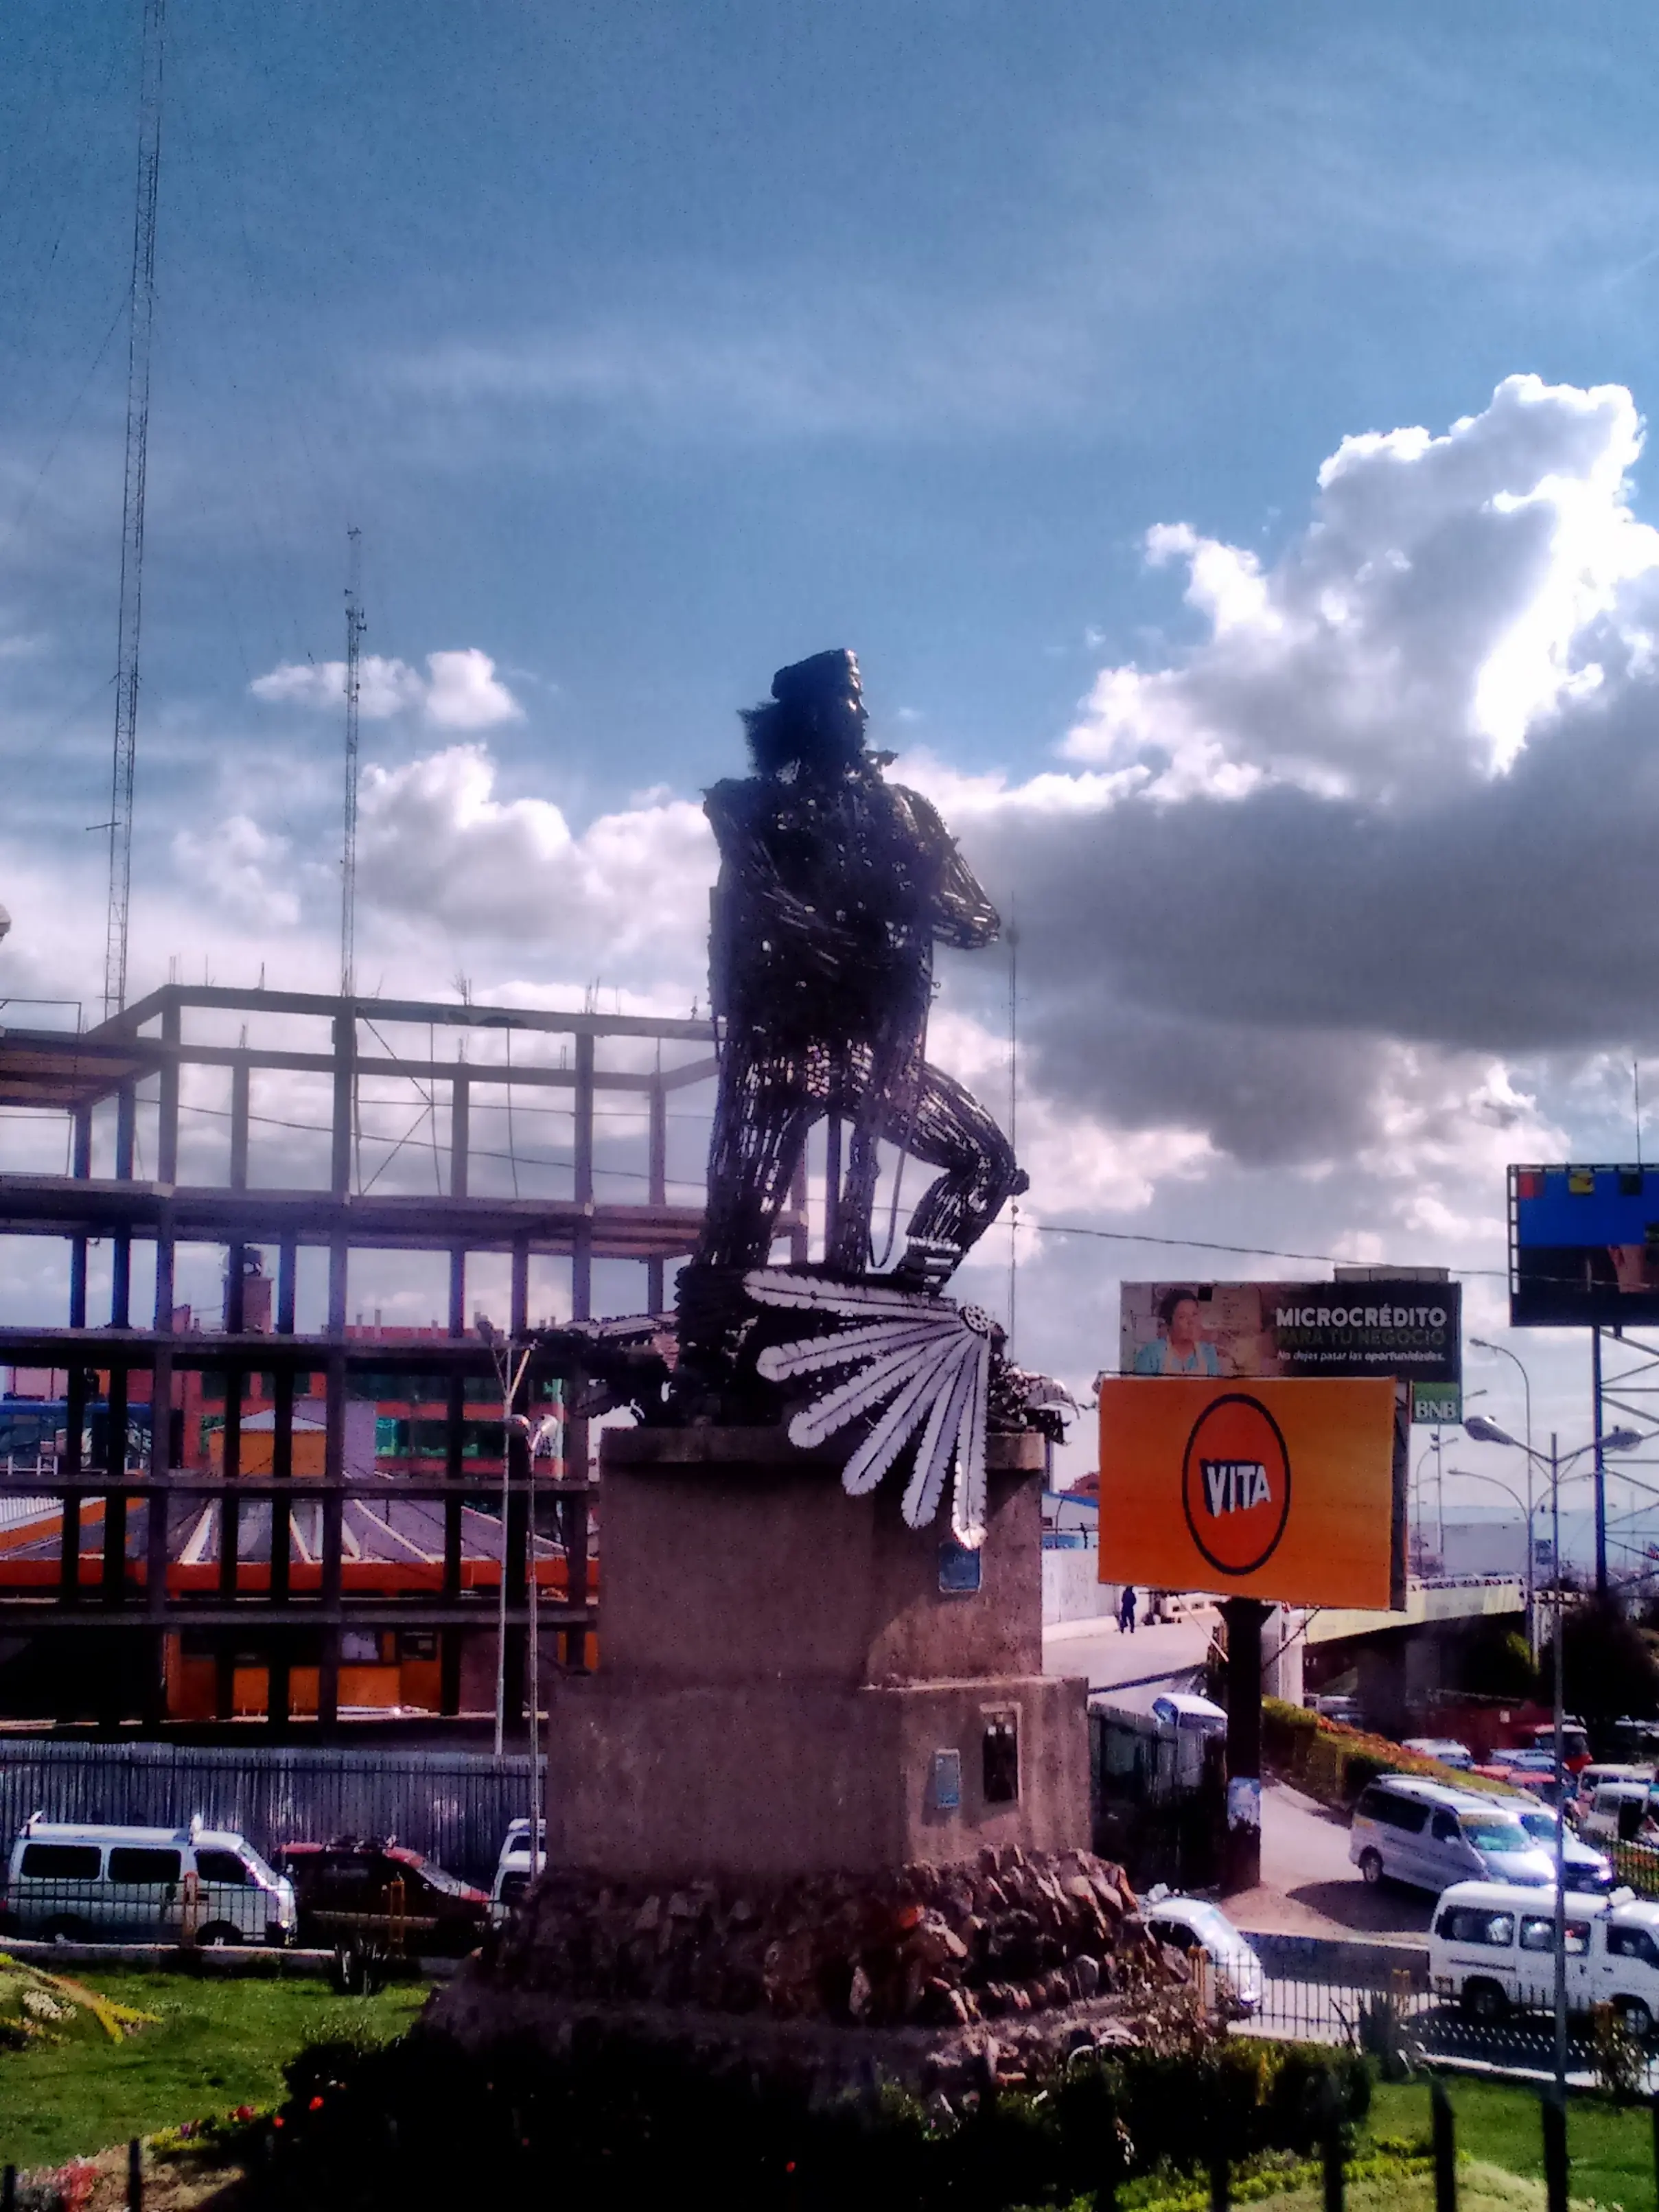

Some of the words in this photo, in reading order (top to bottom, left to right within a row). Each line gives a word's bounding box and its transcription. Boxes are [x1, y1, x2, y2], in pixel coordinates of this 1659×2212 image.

[1276, 1303, 1448, 1327] MICROCRÉDITO
[1277, 1328, 1324, 1345] PARA
[1331, 1328, 1353, 1344] TU
[1358, 1328, 1446, 1346] NEGOCIO
[1415, 1401, 1457, 1420] BNB
[1205, 1464, 1272, 1519] VITA
